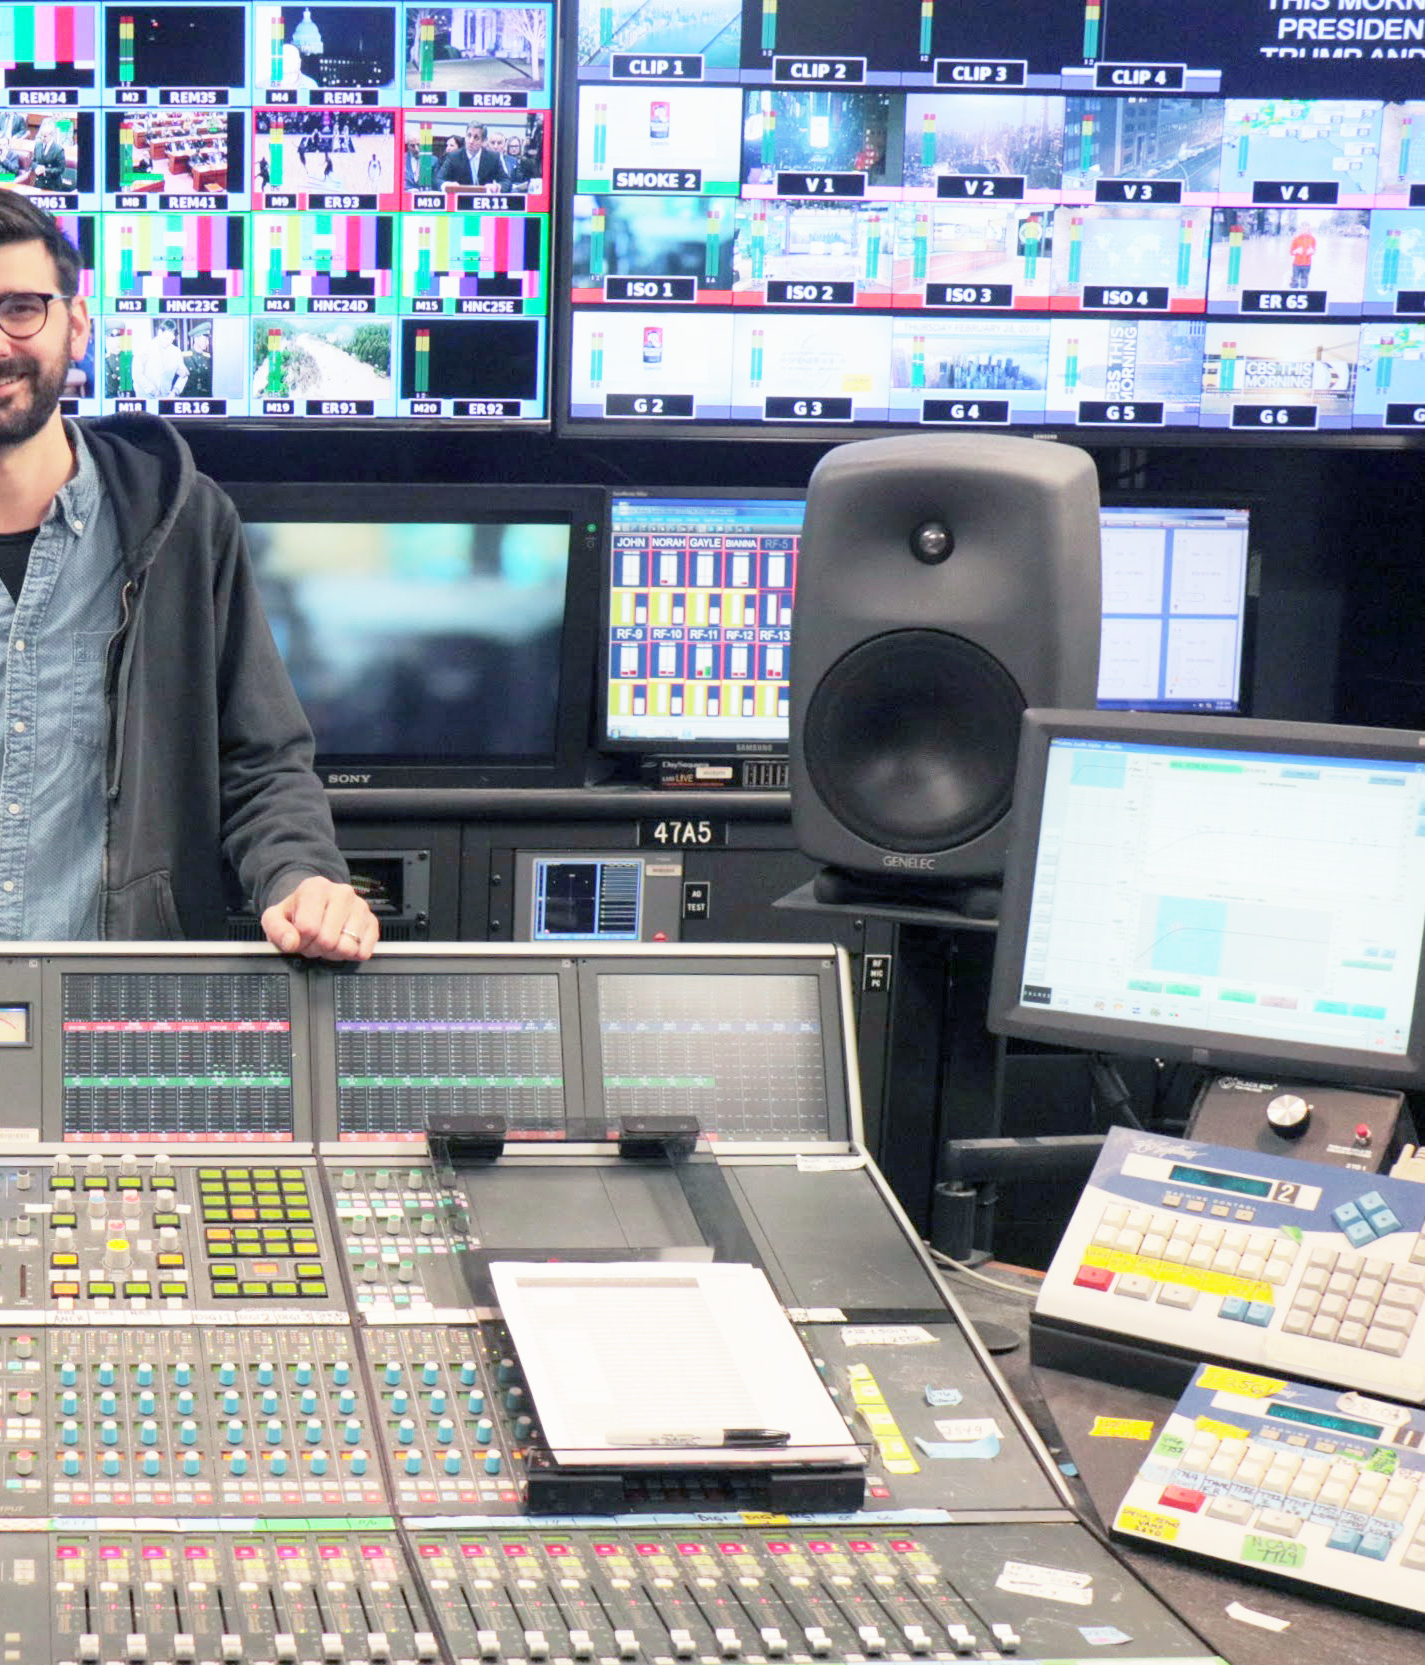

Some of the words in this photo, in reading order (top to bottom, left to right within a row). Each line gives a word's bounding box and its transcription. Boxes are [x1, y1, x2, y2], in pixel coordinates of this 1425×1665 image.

[1278, 18, 1425, 40] PRESIDEN
[628, 59, 668, 76] CLIP
[673, 60, 684, 76] 1
[790, 63, 829, 79] CLIP
[834, 63, 846, 79] 2
[952, 65, 990, 81] CLIP
[993, 67, 1006, 81] 3
[1112, 69, 1151, 85] CLIP
[1153, 70, 1167, 86] 4
[19, 92, 67, 104] REM34
[170, 91, 216, 104] REM35
[324, 92, 363, 104] REM1
[473, 94, 512, 106] REM2
[616, 172, 680, 188] SMOKE
[684, 173, 696, 188] 2
[805, 177, 820, 193] V
[824, 178, 835, 193] 1
[964, 180, 979, 196] V
[981, 180, 994, 196] 2
[1123, 185, 1138, 200] V
[1139, 185, 1152, 200] 3
[1280, 185, 1295, 200] V
[1296, 185, 1310, 200] 4
[170, 197, 216, 209] REM41
[324, 196, 360, 208] ER93
[417, 197, 441, 208] M10
[472, 198, 509, 209] ER11
[627, 282, 659, 297] ISO
[662, 283, 673, 297] 1
[786, 285, 818, 300] ISO
[821, 286, 833, 300] 2
[946, 288, 976, 302] ISO
[980, 288, 992, 302] 3
[1103, 290, 1134, 305] ISO
[1135, 290, 1149, 306] 4
[1259, 294, 1282, 309] ER
[1286, 294, 1308, 309] 65
[166, 300, 219, 312] HNC23C
[267, 300, 290, 311] M14
[312, 300, 368, 312] HNC24D
[462, 300, 514, 313] HNC25E
[1247, 362, 1274, 375] CBS
[1281, 363, 1311, 376] THIS
[1245, 376, 1311, 388] MORNING
[174, 402, 209, 414] ER16
[322, 402, 357, 415] ER91
[469, 403, 504, 415] ER92
[633, 399, 649, 413] G
[651, 399, 664, 413] 2
[793, 401, 809, 417] G
[810, 401, 822, 416] 3
[951, 405, 964, 418] G
[968, 405, 979, 418] 4
[1106, 406, 1120, 421] G
[1123, 406, 1135, 420] 5
[1260, 410, 1273, 424] G
[1276, 410, 1288, 424] 6
[617, 537, 646, 548] JOHN
[652, 537, 686, 547] NORAH
[690, 538, 721, 548] GAYLE
[725, 540, 756, 548] BIANNA
[765, 539, 788, 549] RF-5
[616, 629, 643, 640] RF-9
[653, 629, 682, 639] RF-10
[689, 629, 718, 640] RF-11
[726, 630, 753, 641] RF-12
[760, 631, 791, 641] RF-13
[328, 773, 371, 784] SONY
[675, 774, 694, 783] LIVE
[653, 821, 712, 844] 47A5
[882, 854, 936, 871] GENELEC
[687, 902, 706, 912] TEST
[1278, 1184, 1295, 1203] 2
